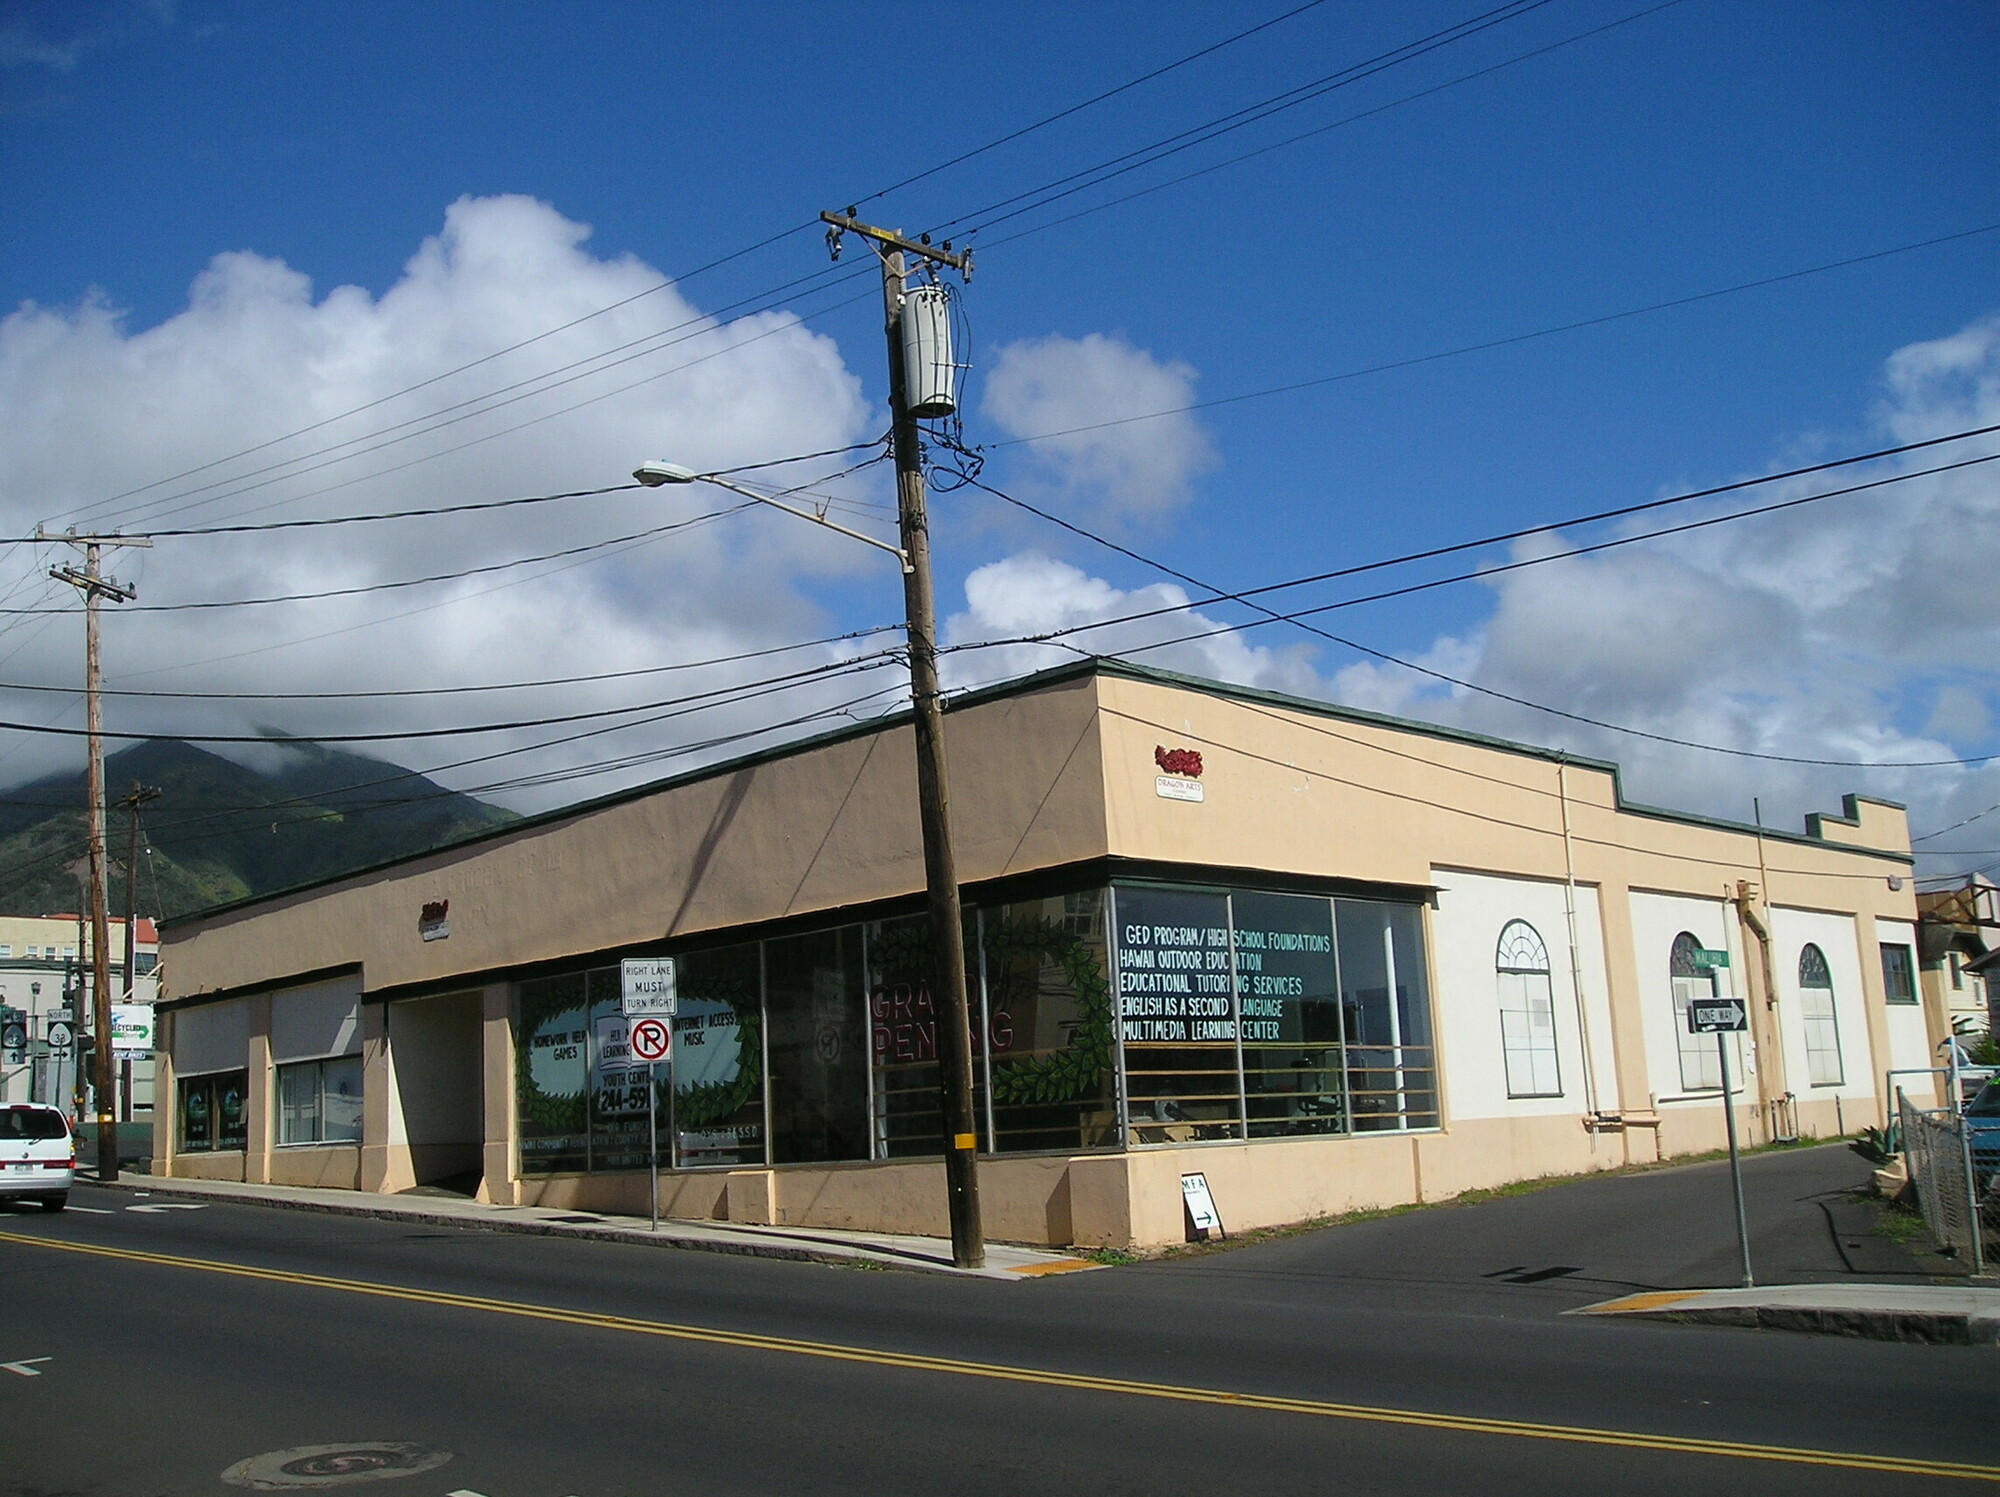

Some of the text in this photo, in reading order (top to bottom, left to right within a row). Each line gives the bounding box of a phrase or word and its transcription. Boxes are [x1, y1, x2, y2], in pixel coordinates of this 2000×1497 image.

[1126, 925, 1150, 944] GED
[1233, 930, 1266, 949] SCHOOL
[1268, 932, 1330, 952] FOUNDATIONS
[1120, 949, 1155, 968] HAWAII
[1158, 950, 1202, 969] OUTDOOR
[626, 966, 670, 976] RIGHT LANE
[635, 982, 663, 992] MUST
[1120, 972, 1192, 993] EDUCATIONAL
[1254, 976, 1303, 995] SERVICES
[627, 998, 672, 1008] TURN RIGHT
[871, 974, 978, 1023] GRAD
[1120, 997, 1283, 1017] ENGLISH AS A SECOND LANGUAGE
[49, 1011, 72, 1020] NORTH
[708, 1012, 735, 1028] ACCESS
[1699, 1009, 1732, 1022] ONE WAY
[684, 1031, 705, 1046] MUSIC
[1122, 1021, 1280, 1040] MULTIMEDIA LEARNING CENTER
[9, 1034, 20, 1044] 32
[534, 1030, 586, 1048] HOMEWORK HELP
[553, 1046, 578, 1061] GAMES
[603, 1069, 651, 1087] YOUTH CENTE
